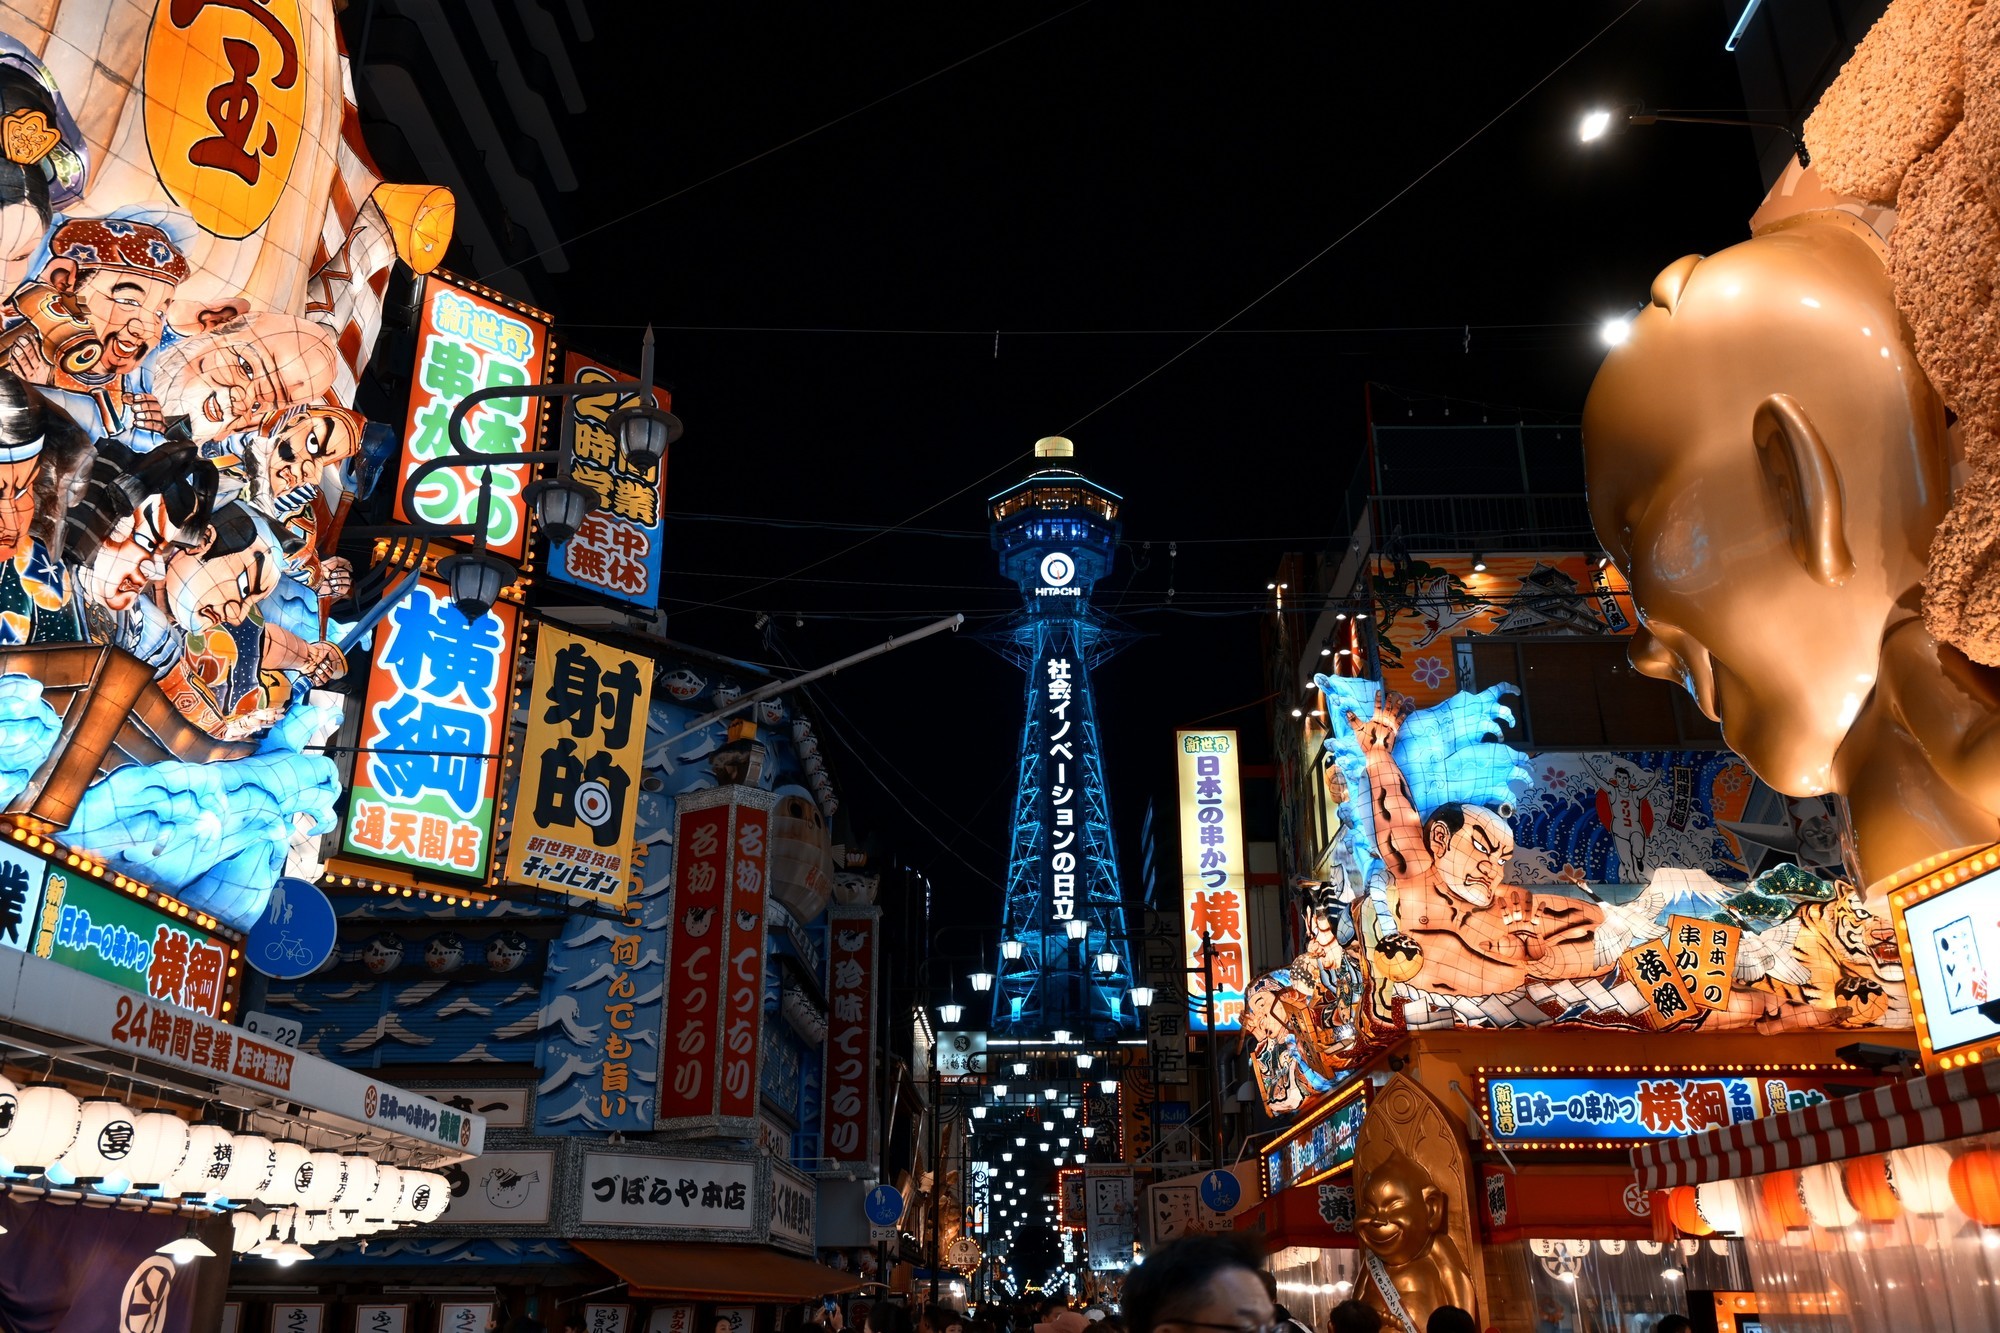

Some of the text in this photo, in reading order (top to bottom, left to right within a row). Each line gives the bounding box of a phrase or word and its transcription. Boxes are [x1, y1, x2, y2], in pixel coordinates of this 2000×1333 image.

[436, 292, 532, 361] 新世界
[413, 340, 475, 519] 串かつ
[570, 542, 645, 591] 無休
[1035, 587, 1080, 596] HITACHI
[374, 590, 501, 814] 横綱
[533, 643, 643, 847] 射的
[1184, 735, 1230, 754] 新世界
[1048, 658, 1076, 920] 社会イノベーションの日立
[353, 804, 480, 868] 通天閣店
[1196, 755, 1227, 888] 日本一の串かつ
[523, 856, 621, 895] チャンピオン
[527, 835, 622, 872] 新世界遊技場
[59, 907, 223, 1016] 日本一の串かつ 横綱
[1634, 949, 1688, 1020] 横綱
[1675, 924, 1701, 994] 串かつ
[1704, 930, 1727, 1002] 日本一の
[111, 994, 290, 1087] 24時間営業 年中無休
[1495, 1085, 1514, 1133] 新世界
[1516, 1081, 1730, 1131] 日本一の串かつ 横綱
[1729, 1082, 1755, 1125] 名門
[207, 1142, 234, 1181] 横綱
[591, 1175, 746, 1212] づぼらや本店
[1321, 1195, 1356, 1222] 横
[871, 1230, 896, 1239] 9-22
